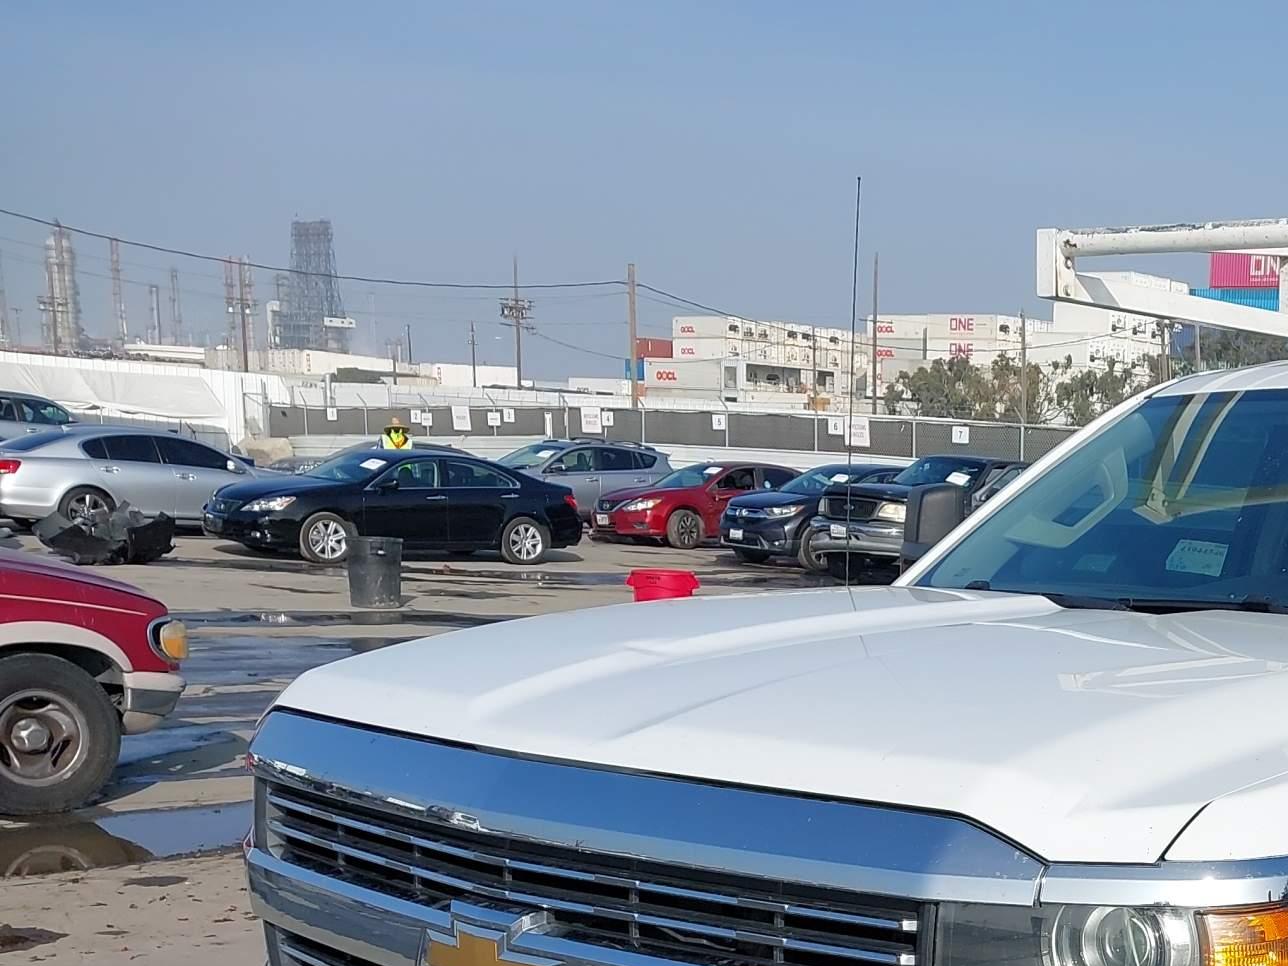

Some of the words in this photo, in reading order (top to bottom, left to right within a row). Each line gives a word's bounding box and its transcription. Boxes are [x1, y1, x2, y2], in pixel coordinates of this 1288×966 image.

[1250, 255, 1279, 275] ON
[950, 318, 974, 331] ONE
[950, 343, 974, 356] ONE
[656, 371, 677, 381] OOCL
